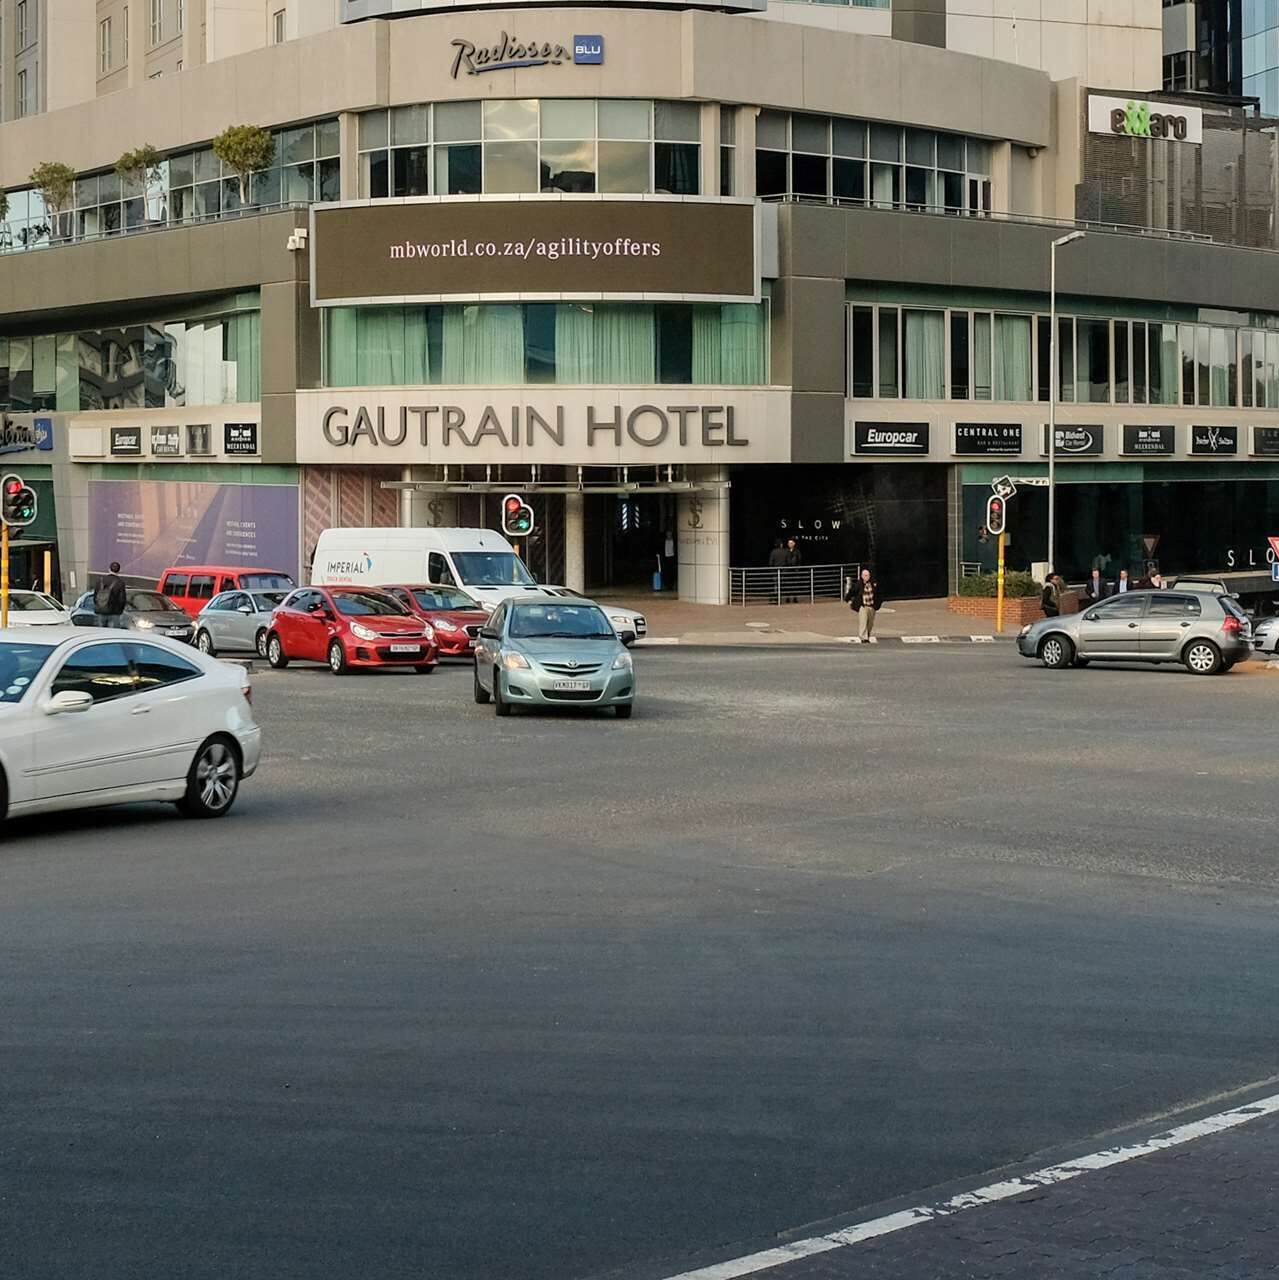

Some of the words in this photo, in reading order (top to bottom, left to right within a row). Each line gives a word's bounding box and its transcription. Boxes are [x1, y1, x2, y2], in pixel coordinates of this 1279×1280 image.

[450, 30, 571, 79] Radisson
[575, 45, 601, 54] BLU
[1110, 101, 1187, 140] exxaro
[390, 238, 661, 260] mbworld.co.za/agilityoffers
[321, 405, 565, 448] GAUTRAIN
[586, 405, 750, 448] HOTEL
[957, 428, 999, 437] CENTRAL
[1002, 428, 1020, 437] ONE
[867, 429, 918, 444] Europcar
[781, 519, 841, 529] SLOW
[327, 561, 364, 573] IMPERIAL
